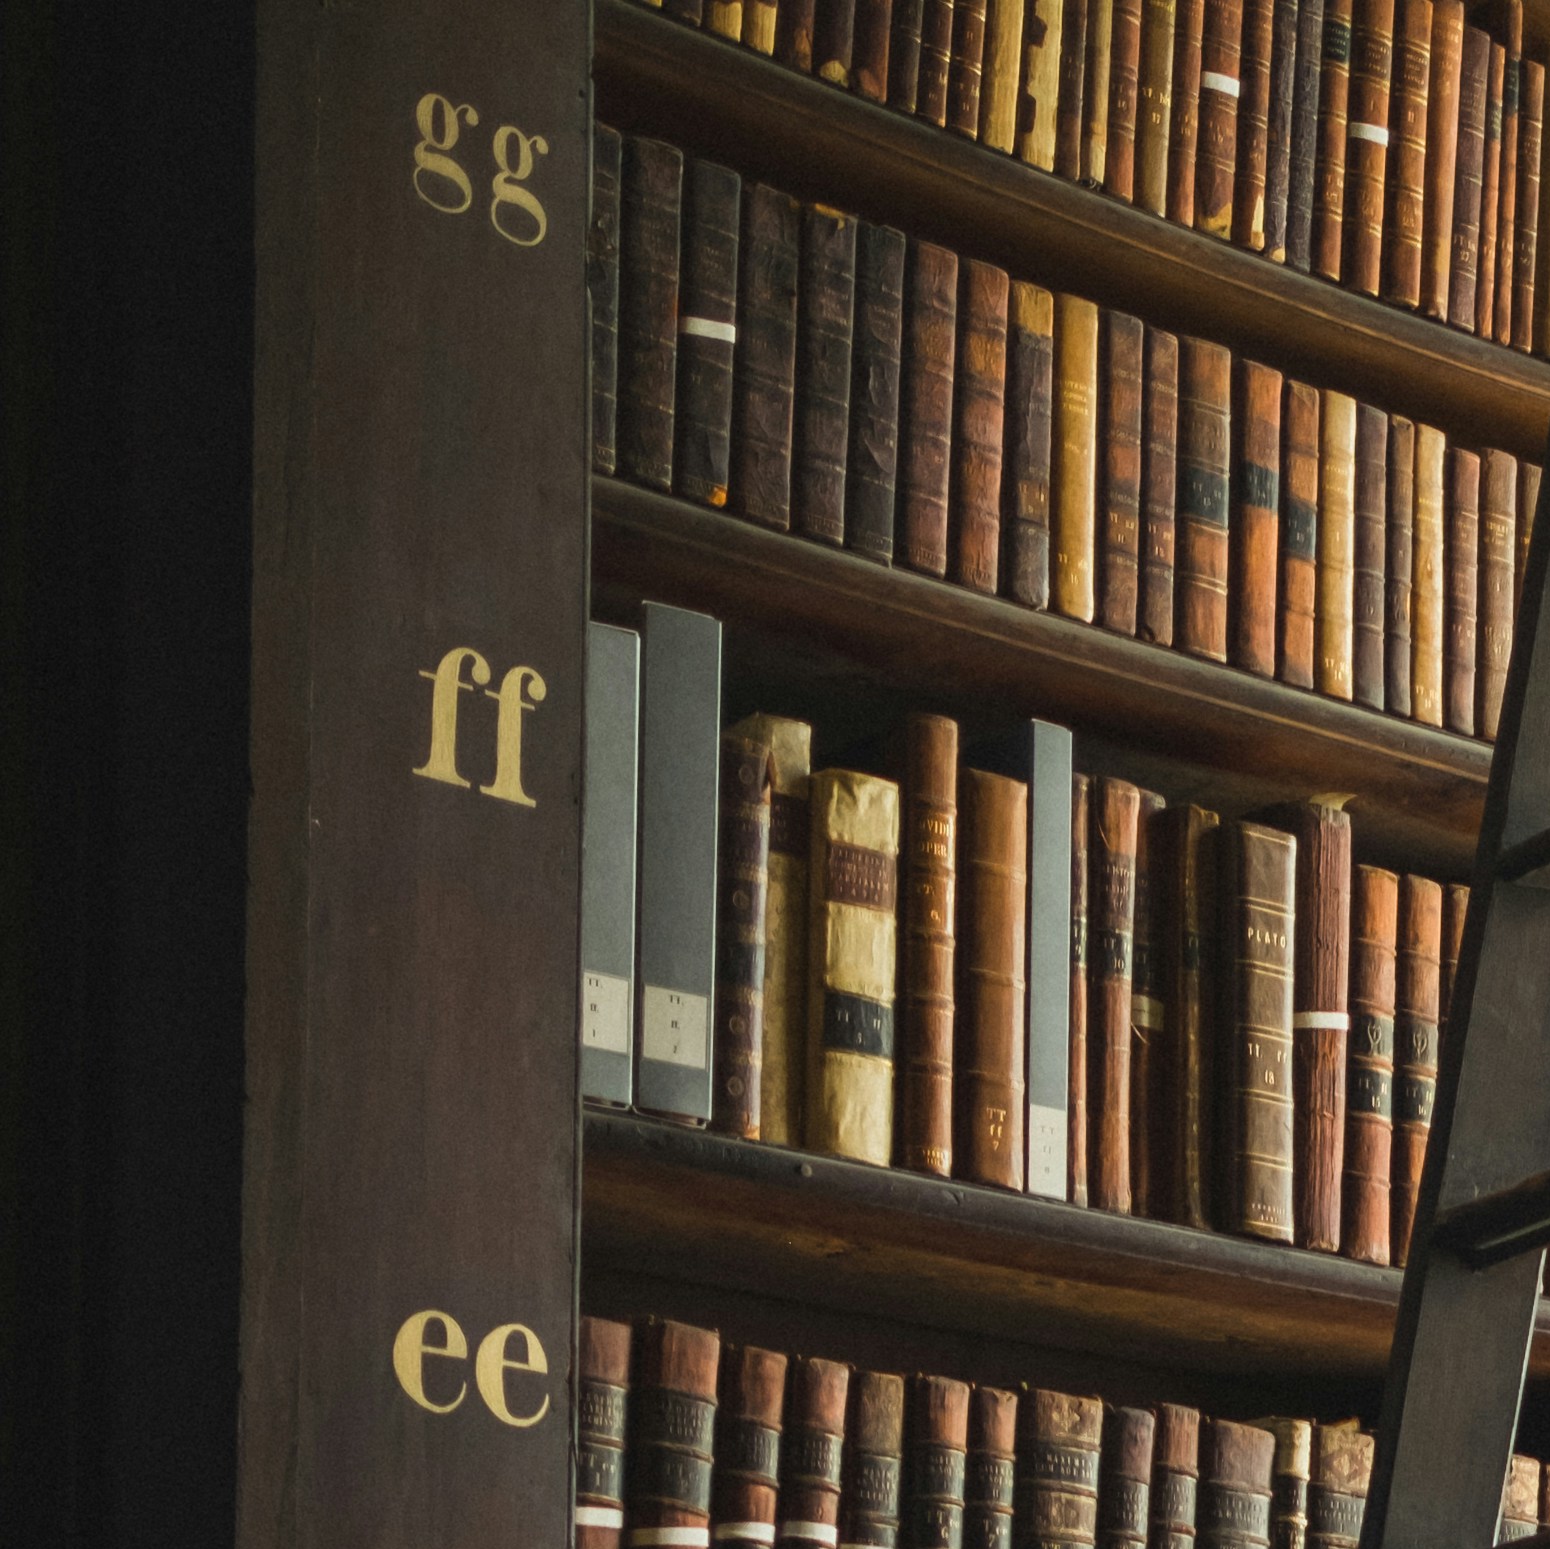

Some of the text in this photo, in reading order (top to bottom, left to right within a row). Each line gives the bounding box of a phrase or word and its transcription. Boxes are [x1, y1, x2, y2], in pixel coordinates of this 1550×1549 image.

[413, 91, 549, 247] gg
[414, 646, 548, 806] ff
[1247, 927, 1287, 949] PLATO
[986, 1106, 1006, 1122] TT
[392, 1308, 549, 1429] ee
